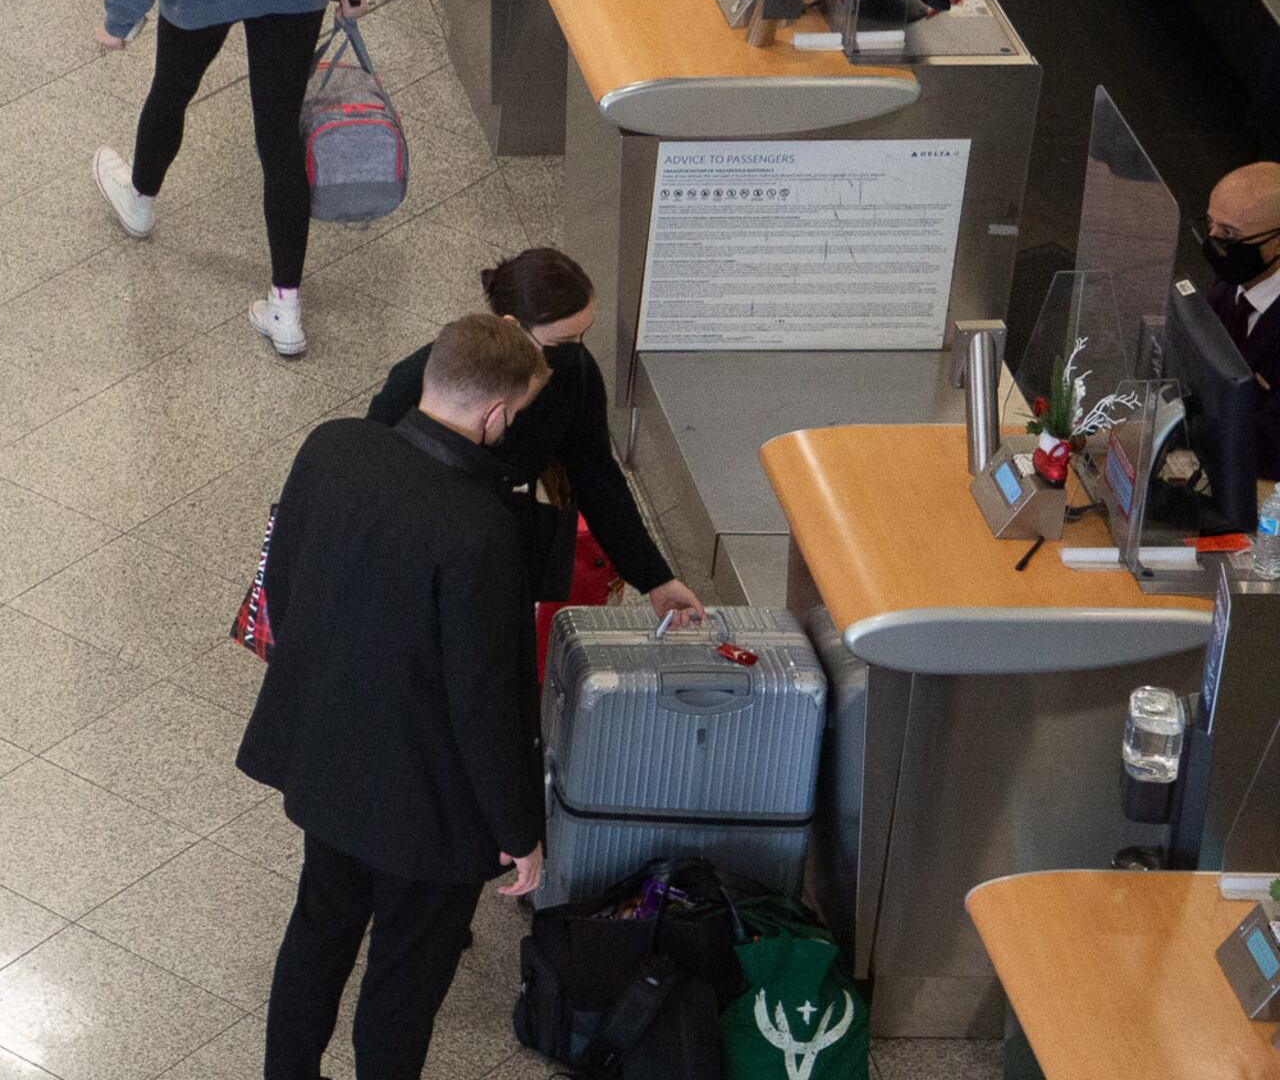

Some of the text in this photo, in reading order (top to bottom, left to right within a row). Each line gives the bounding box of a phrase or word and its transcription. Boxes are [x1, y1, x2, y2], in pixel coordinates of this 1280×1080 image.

[664, 154, 796, 164] ADVICE TO PASSENGERS
[244, 615, 256, 646] NO
